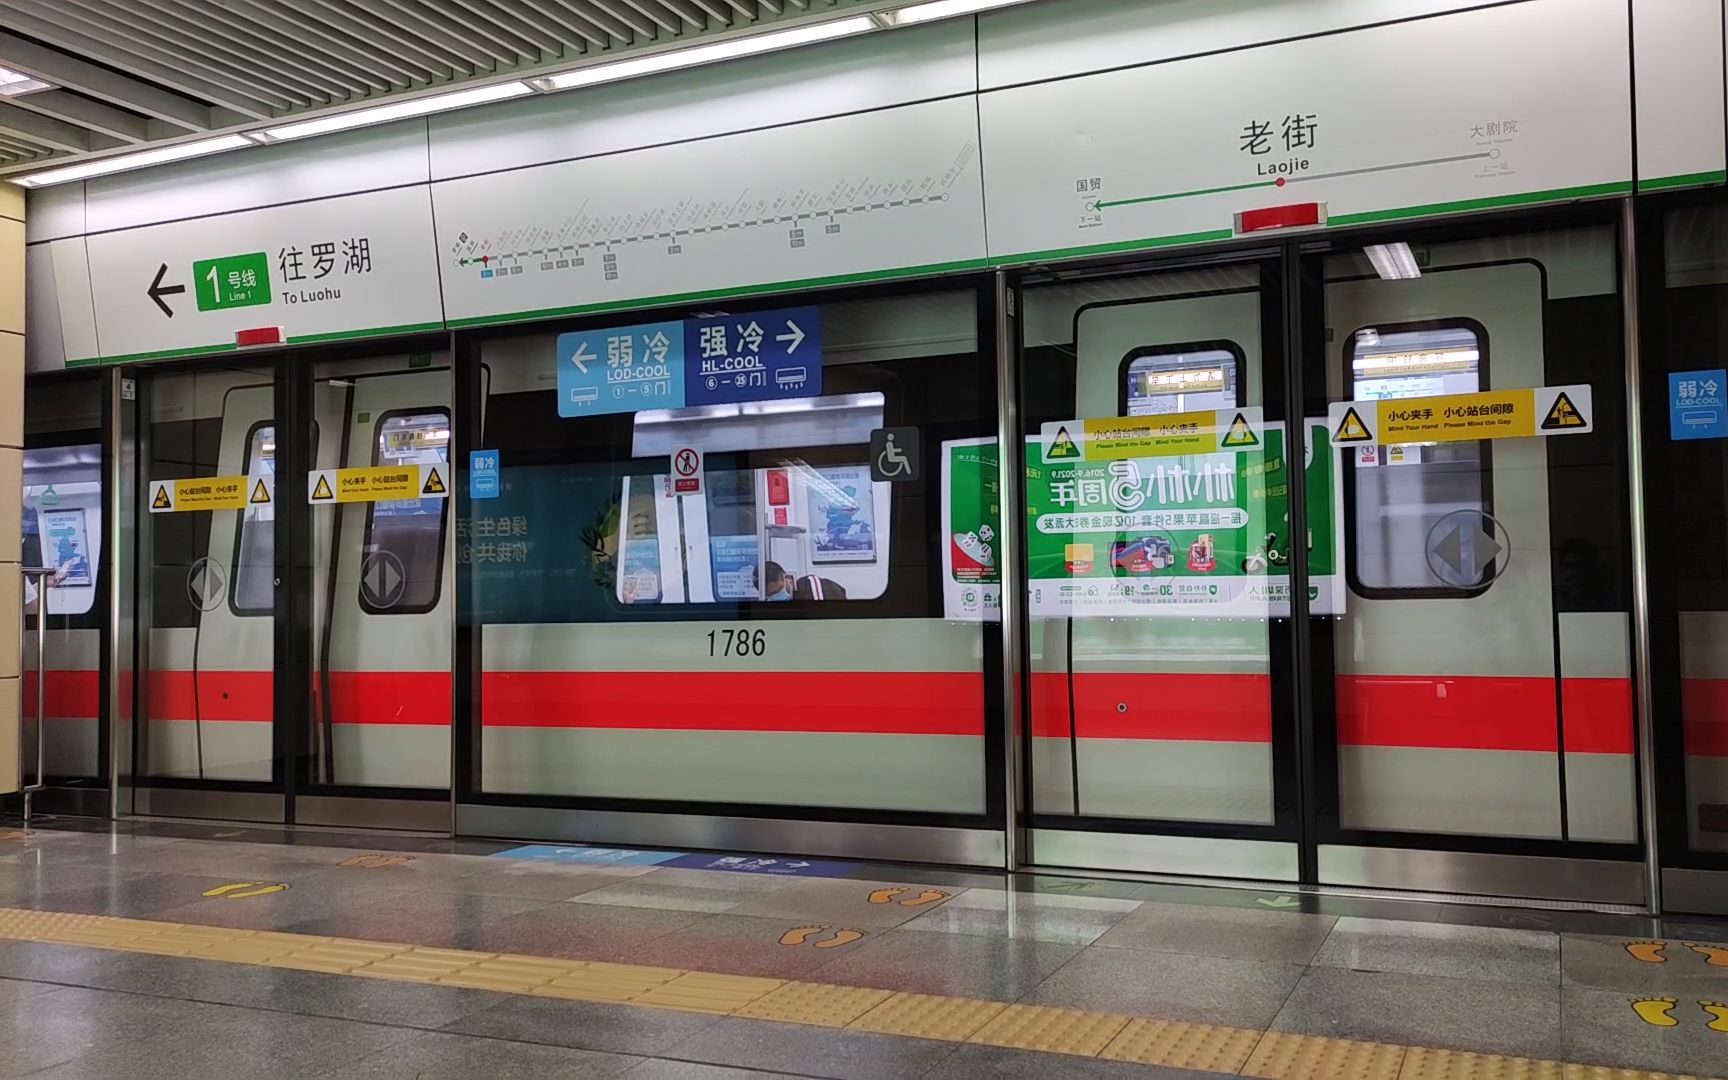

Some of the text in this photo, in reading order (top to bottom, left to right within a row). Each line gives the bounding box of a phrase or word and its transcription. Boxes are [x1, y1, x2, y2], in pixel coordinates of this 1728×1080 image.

[1239, 113, 1319, 156] 老街
[1469, 120, 1518, 139] 大剧院
[1256, 157, 1310, 176] Laojie
[1077, 177, 1101, 192] 国贸
[278, 237, 372, 284] 往罗湖
[228, 269, 257, 289] 号线
[229, 290, 252, 302] Line 1
[282, 287, 342, 305] To Luohu
[699, 320, 765, 358] 强冷
[607, 331, 671, 369] 弱冷
[607, 364, 671, 381] LOD-COOL
[702, 355, 764, 372] HL-COOL
[1678, 379, 1719, 398] 弱冷
[1387, 402, 1515, 422] 小心夹手 小心站台间隙
[1094, 422, 1199, 440] 小心站台间隙 小心夹手
[1497, 418, 1512, 426] Gap
[707, 629, 766, 657] 1786
